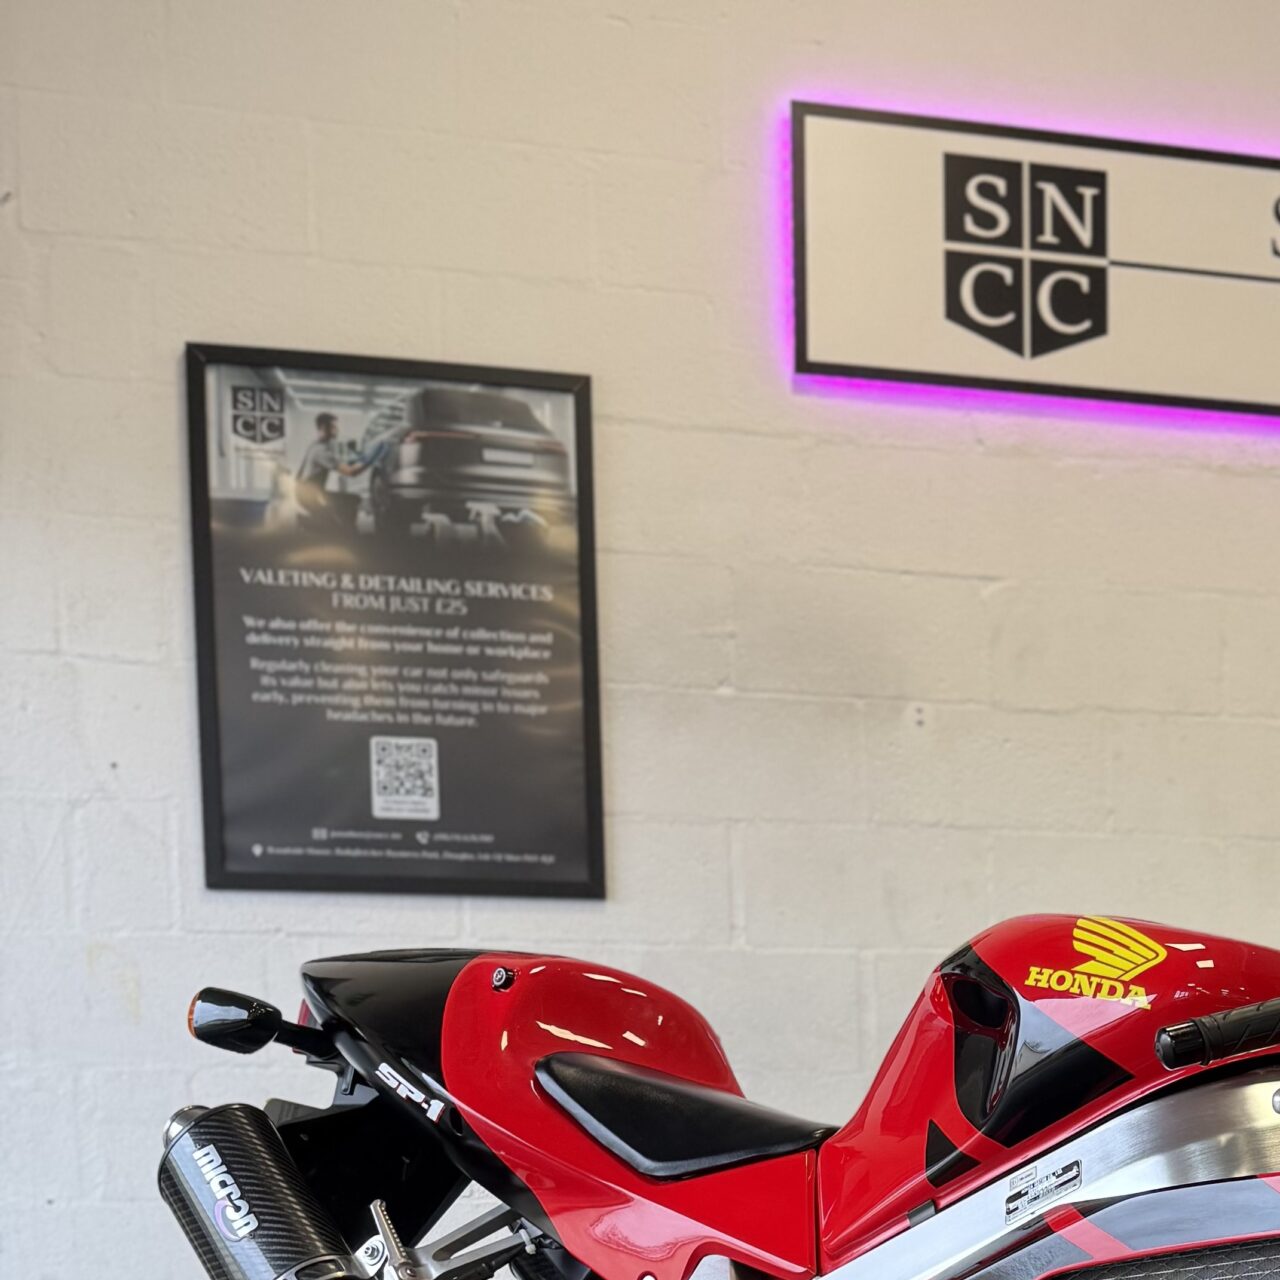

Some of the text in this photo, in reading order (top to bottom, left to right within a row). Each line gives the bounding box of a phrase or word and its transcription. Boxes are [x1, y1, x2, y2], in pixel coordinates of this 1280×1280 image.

[239, 566, 554, 602] VALETING & DETAILING SERVICES
[332, 591, 468, 616] FROM JUST £25
[1024, 966, 1152, 1010] HONDA
[375, 1062, 445, 1123] SP-1
